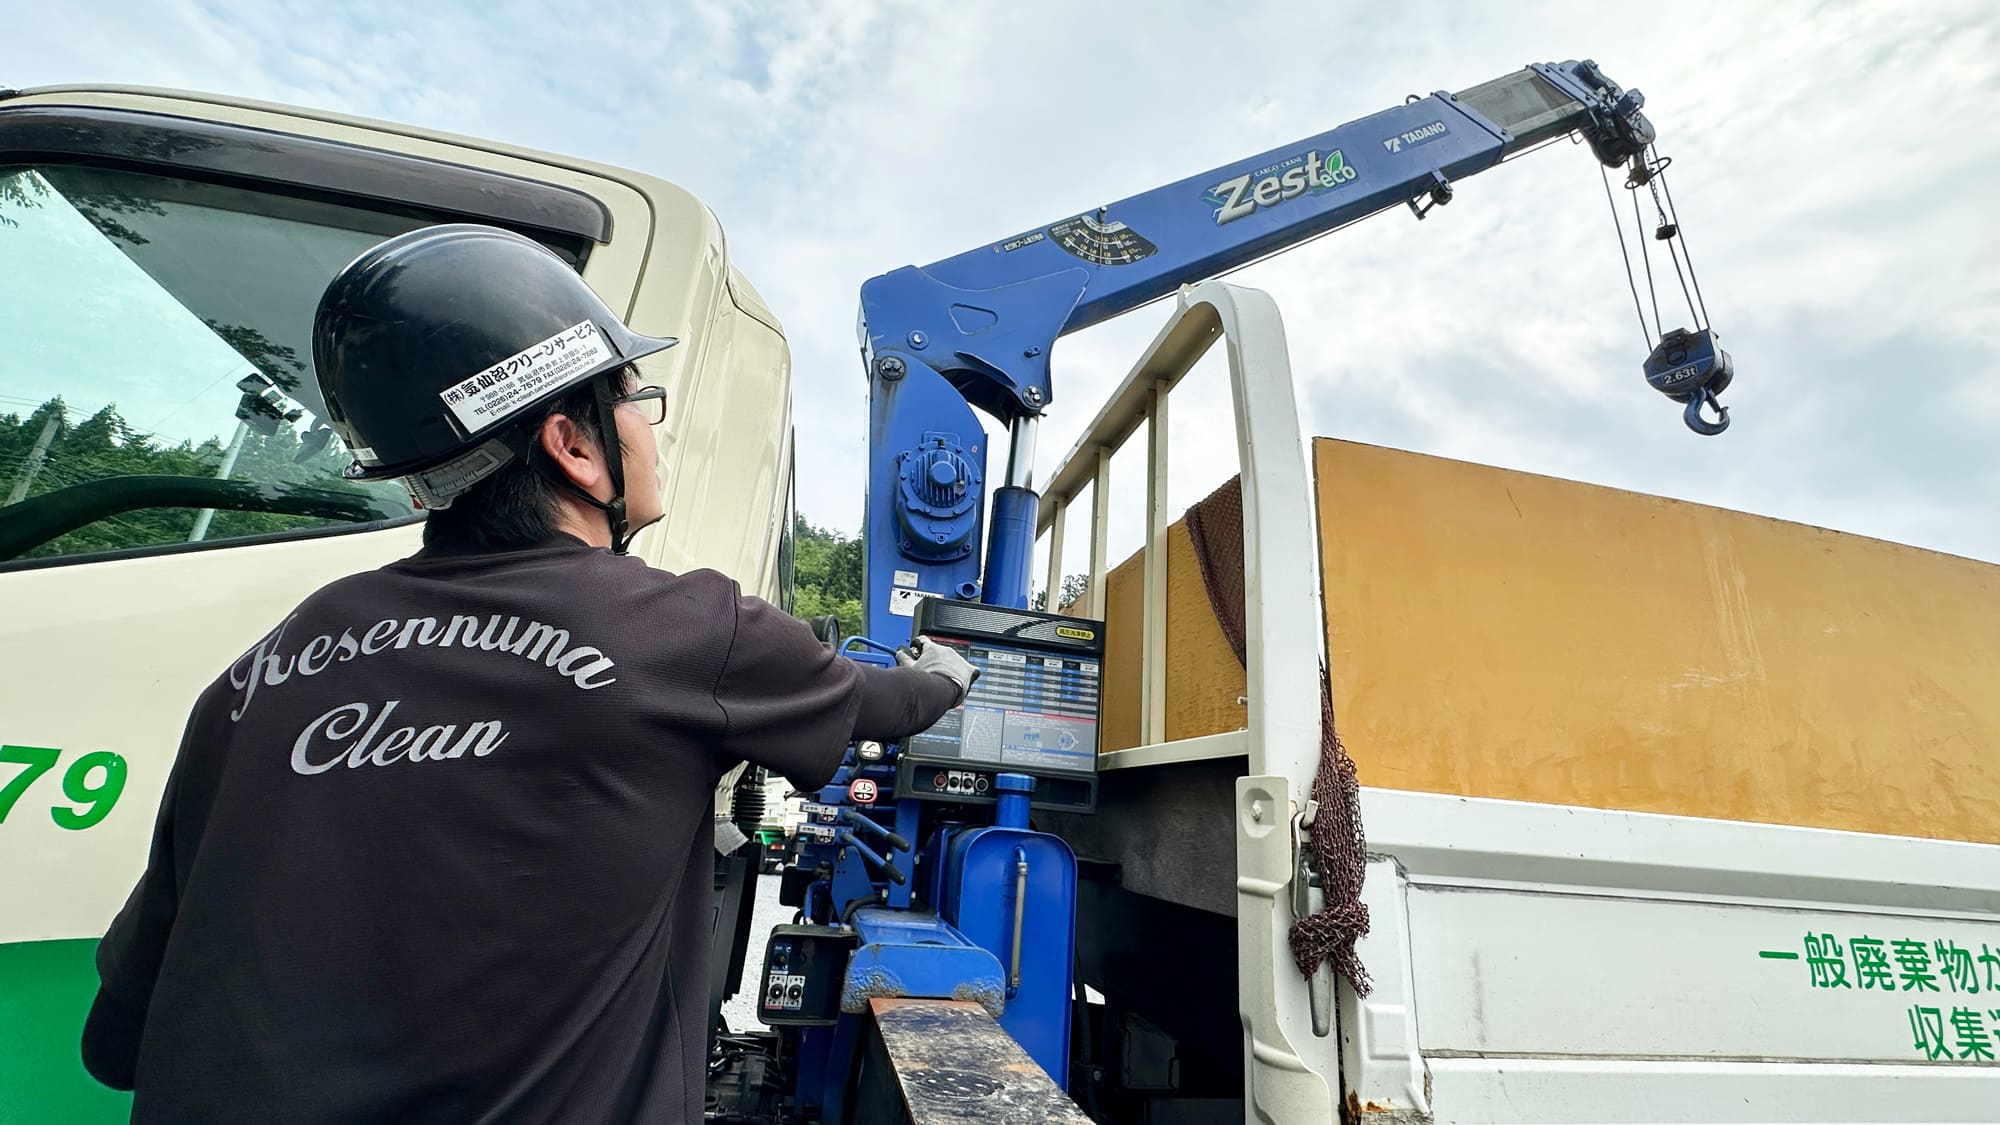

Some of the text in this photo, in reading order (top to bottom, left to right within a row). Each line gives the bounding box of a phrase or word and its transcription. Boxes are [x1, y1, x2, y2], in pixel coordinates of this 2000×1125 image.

[1402, 121, 1446, 144] TADANO
[1213, 151, 1357, 225] Zest eco
[1254, 165, 1279, 177] CARGO
[443, 322, 597, 406] (株)気仙沼クリーンサービス
[1664, 367, 1696, 384] 2.63t
[229, 613, 617, 722] Kesennuma
[290, 699, 511, 776] Clean
[0, 745, 128, 830] 79
[1907, 1004, 2000, 1062] 収集
